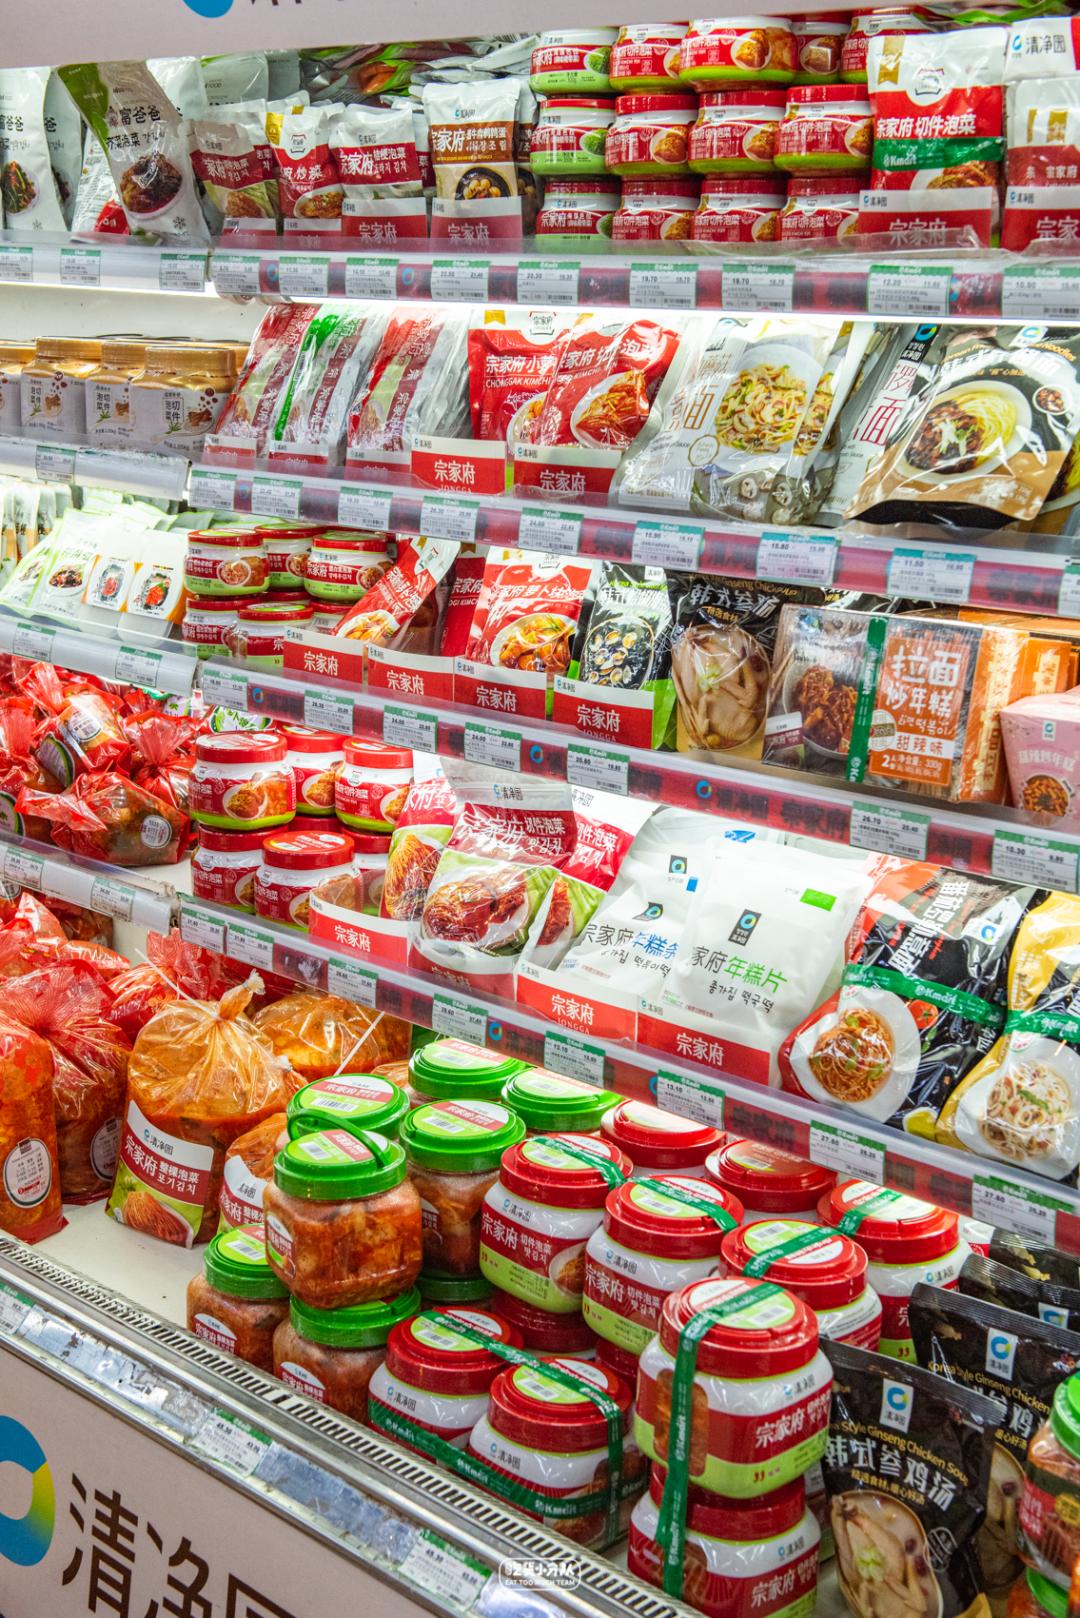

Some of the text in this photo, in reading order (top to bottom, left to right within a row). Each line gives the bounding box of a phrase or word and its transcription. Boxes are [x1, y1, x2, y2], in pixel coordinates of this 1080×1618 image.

[1026, 35, 1066, 54] 清净园
[877, 113, 976, 138] 宗家府 切件泡菜
[359, 221, 398, 244] 宗家府
[447, 222, 490, 246] 宗家府
[889, 218, 947, 246] 宗家府
[485, 355, 526, 374] 宗家府
[434, 460, 475, 486] 宗家府
[539, 469, 587, 494] 宗家府
[303, 651, 338, 676] 宗家府
[891, 644, 962, 687] 拉面
[386, 671, 425, 696] 宗家府
[476, 686, 517, 713] 宗家府
[885, 679, 954, 719] 炒年糕
[577, 705, 621, 732] 宗家府
[896, 734, 944, 755] 甜辣味
[881, 754, 890, 768] 2
[525, 815, 566, 836] 切件泡菜
[334, 925, 371, 953] 宗家府
[691, 945, 788, 994] 家府 年糕片
[551, 994, 594, 1026] 宗家府
[708, 979, 774, 1015] 종가집 떡국떡
[557, 1017, 590, 1035] JONGGA
[676, 1032, 724, 1066] 宗家府
[150, 1135, 174, 1157] 清净园
[124, 1135, 200, 1184] 宗家府 整棵泡菜
[157, 1174, 197, 1196] 포기김치
[481, 1212, 519, 1251] 宗家府
[614, 1255, 638, 1275] 清净园
[584, 1263, 625, 1303] 宗家府
[394, 1391, 417, 1411] 清净园
[974, 1372, 1050, 1413] Ginseng Chicken
[755, 1407, 804, 1448] 宗家府
[841, 1421, 866, 1435] Style
[867, 1425, 906, 1451] Ginseng
[906, 1437, 944, 1469] Chicken
[499, 1450, 521, 1470] 清净园
[825, 1433, 957, 1511] 韩式参鸡汤
[751, 1570, 795, 1609] 宗家府
